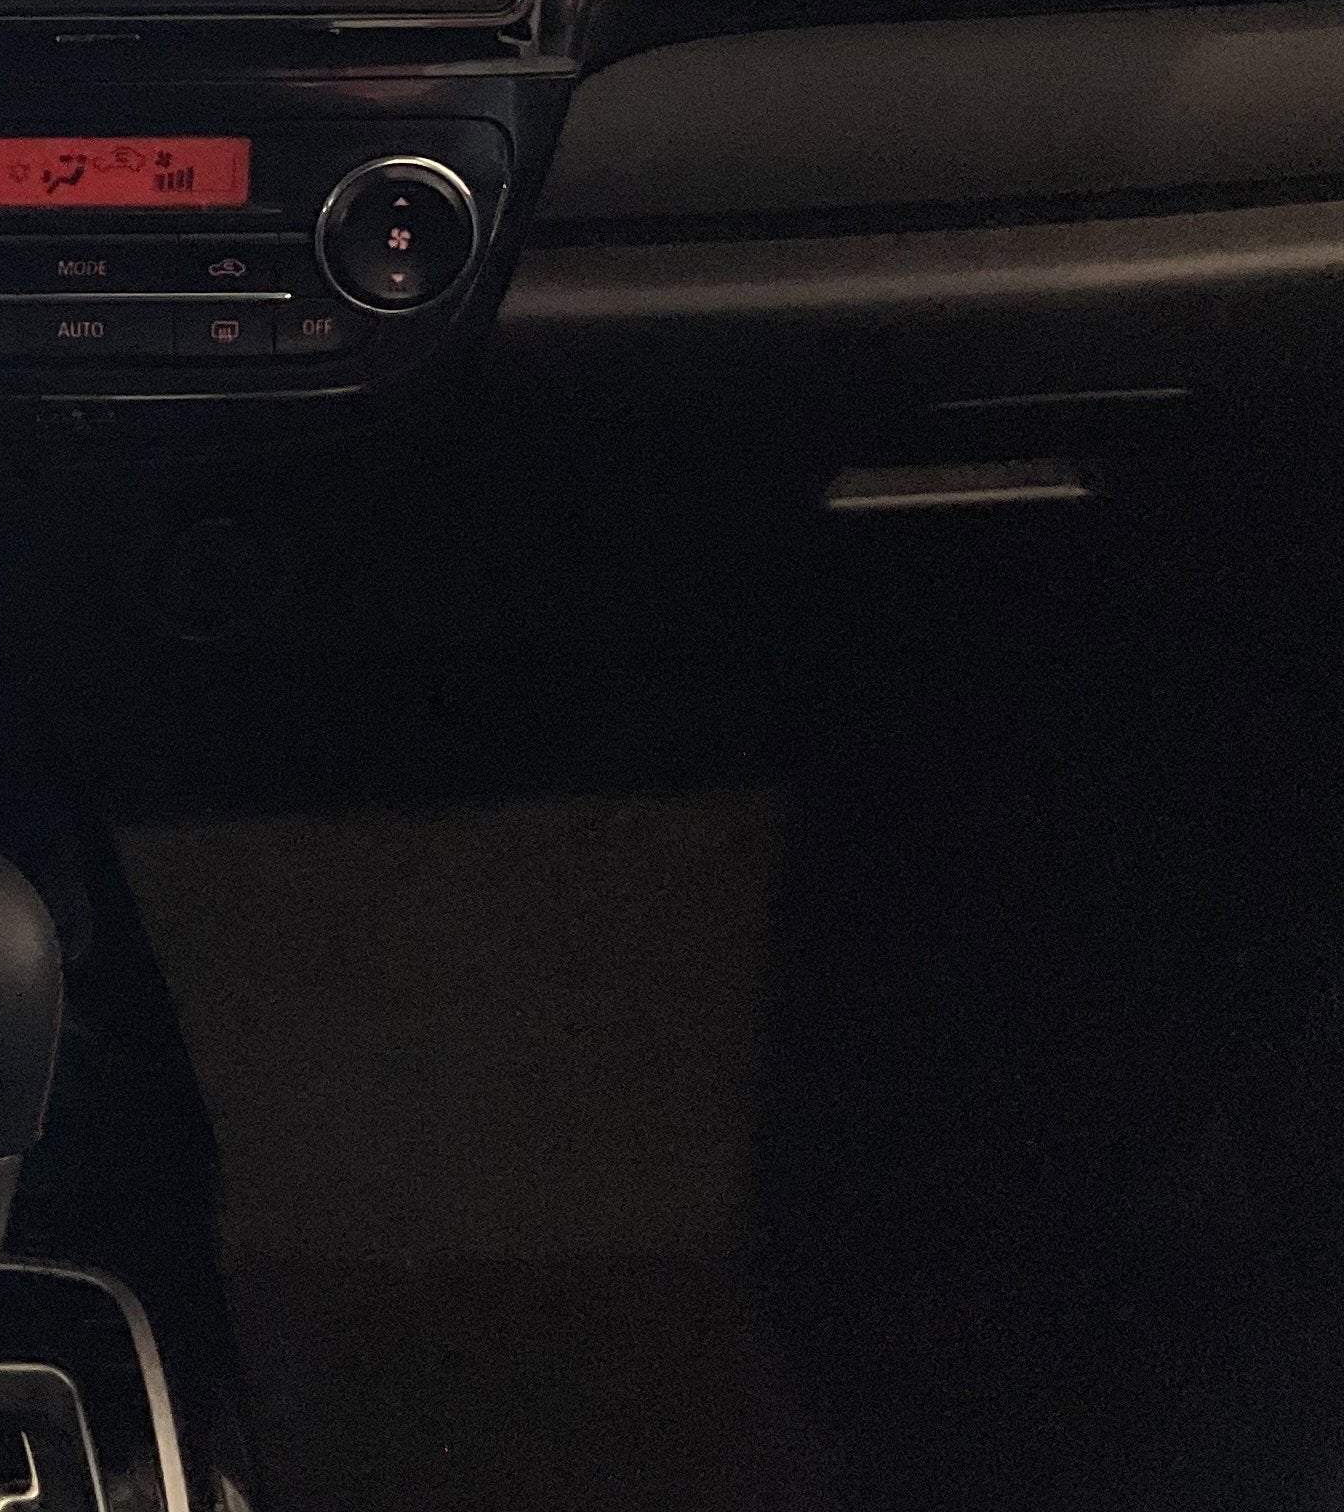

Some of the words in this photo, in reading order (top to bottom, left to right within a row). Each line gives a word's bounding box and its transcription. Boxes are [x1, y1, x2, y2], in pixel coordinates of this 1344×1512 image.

[57, 260, 108, 277] MODE
[57, 321, 104, 338] AUTO
[302, 317, 332, 336] OFF
